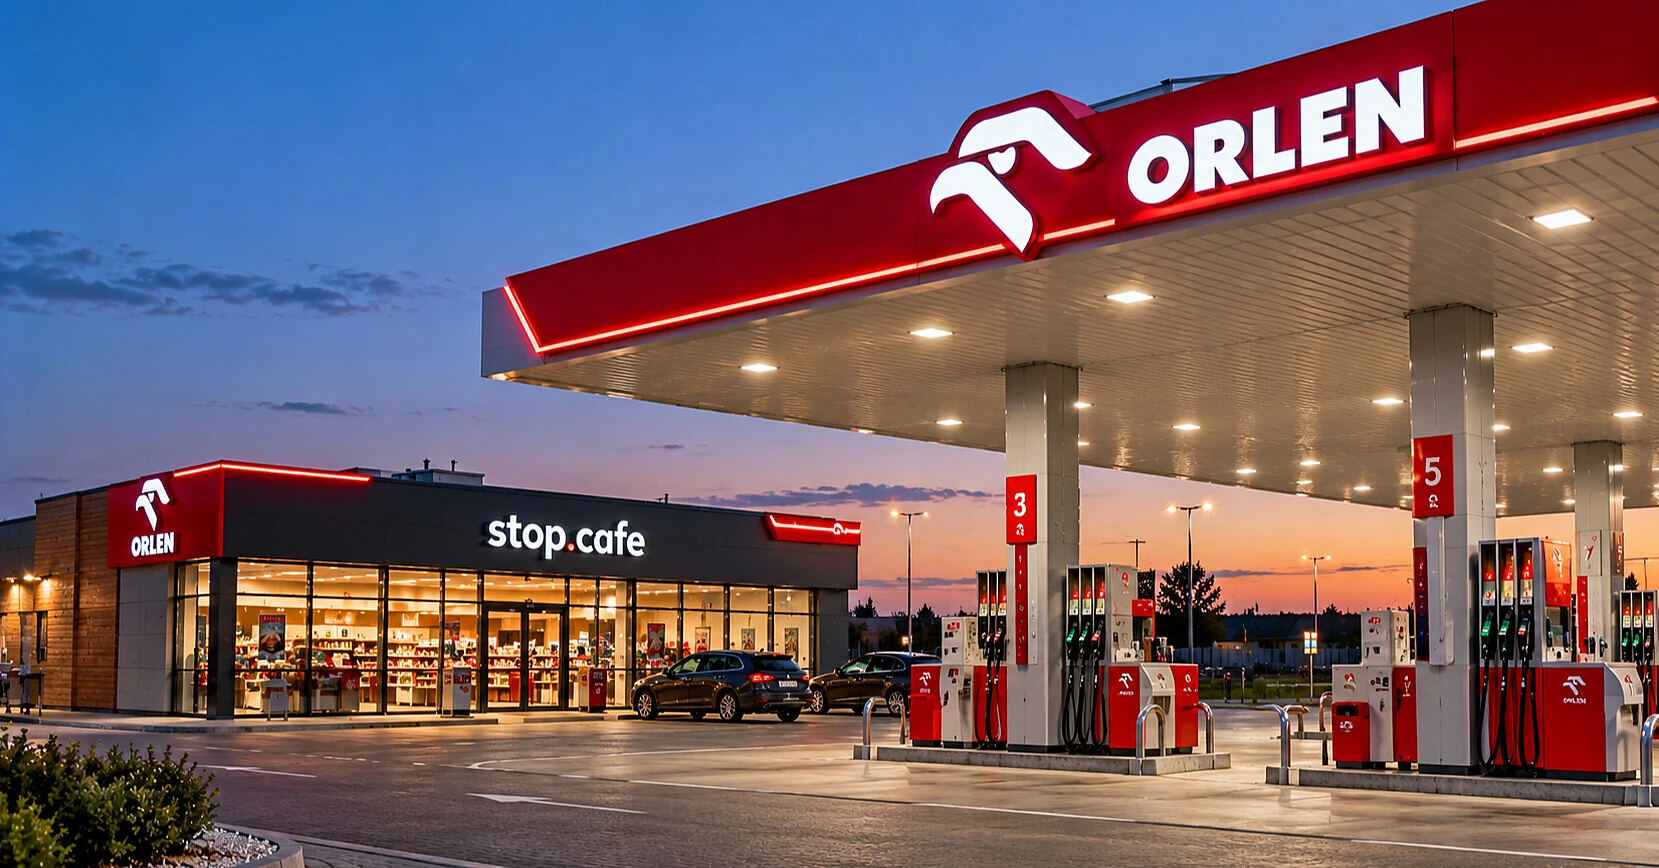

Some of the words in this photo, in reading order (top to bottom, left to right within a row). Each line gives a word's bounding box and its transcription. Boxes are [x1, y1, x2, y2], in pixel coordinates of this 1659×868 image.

[1127, 65, 1426, 205] ORLEN
[1425, 456, 1442, 487] 5
[1013, 492, 1027, 517] 3
[131, 531, 175, 557] ORLEN
[487, 514, 646, 560] stop.cafe
